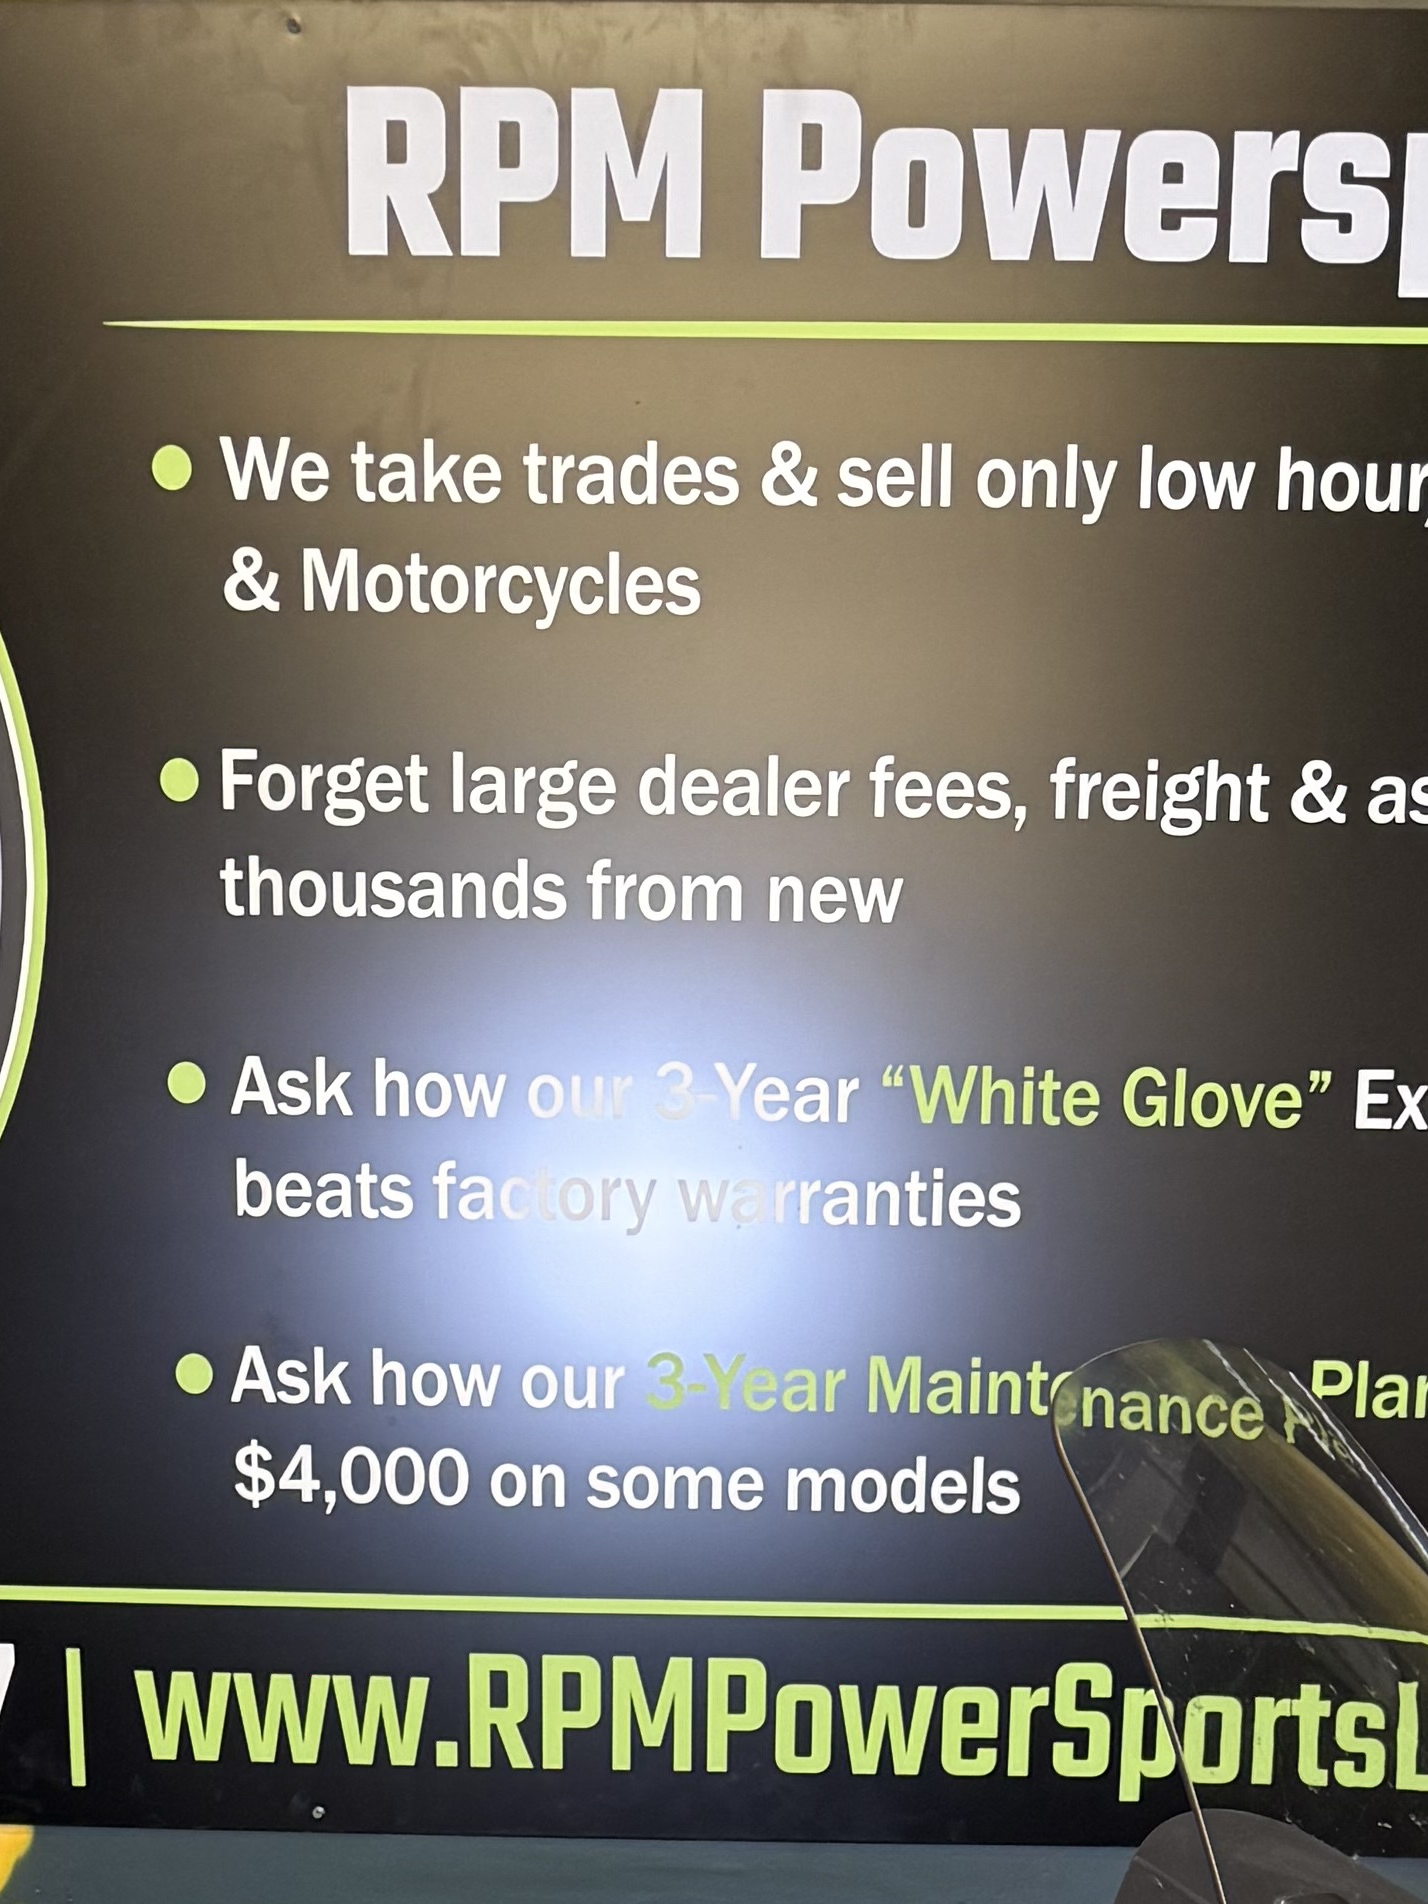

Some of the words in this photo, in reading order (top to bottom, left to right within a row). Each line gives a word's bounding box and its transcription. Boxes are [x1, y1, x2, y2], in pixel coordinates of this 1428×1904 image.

[347, 86, 702, 258] RPM
[219, 436, 329, 501] We
[351, 438, 501, 503] take
[523, 440, 739, 505] trades
[762, 441, 817, 506] &
[838, 443, 952, 507] sell
[978, 444, 1118, 524] only
[1140, 445, 1256, 510] low
[224, 546, 280, 611] &
[303, 548, 700, 629] Motorcycles
[222, 748, 429, 826] Forget
[453, 751, 616, 829] large
[639, 754, 850, 817] dealer
[869, 755, 1026, 831] fees,
[1050, 757, 1270, 836] freight
[1291, 760, 1347, 823] &
[220, 855, 566, 919] thousands
[586, 859, 742, 921] from
[770, 876, 903, 923] new
[231, 1056, 353, 1115] Ask
[376, 1058, 506, 1117] how
[528, 1075, 632, 1118] our
[655, 1062, 859, 1123] 3-Year
[236, 1158, 413, 1218] beats
[433, 1160, 659, 1237] factory
[679, 1168, 1021, 1227] warranties
[231, 1345, 351, 1404] Ask
[373, 1348, 501, 1406] how
[522, 1365, 625, 1409] our
[644, 1350, 846, 1412] 3-Year
[869, 1353, 1264, 1440] Maintenance
[235, 1439, 469, 1514] $4,000
[491, 1463, 565, 1507] on
[587, 1465, 764, 1510] some
[788, 1456, 1020, 1514] models
